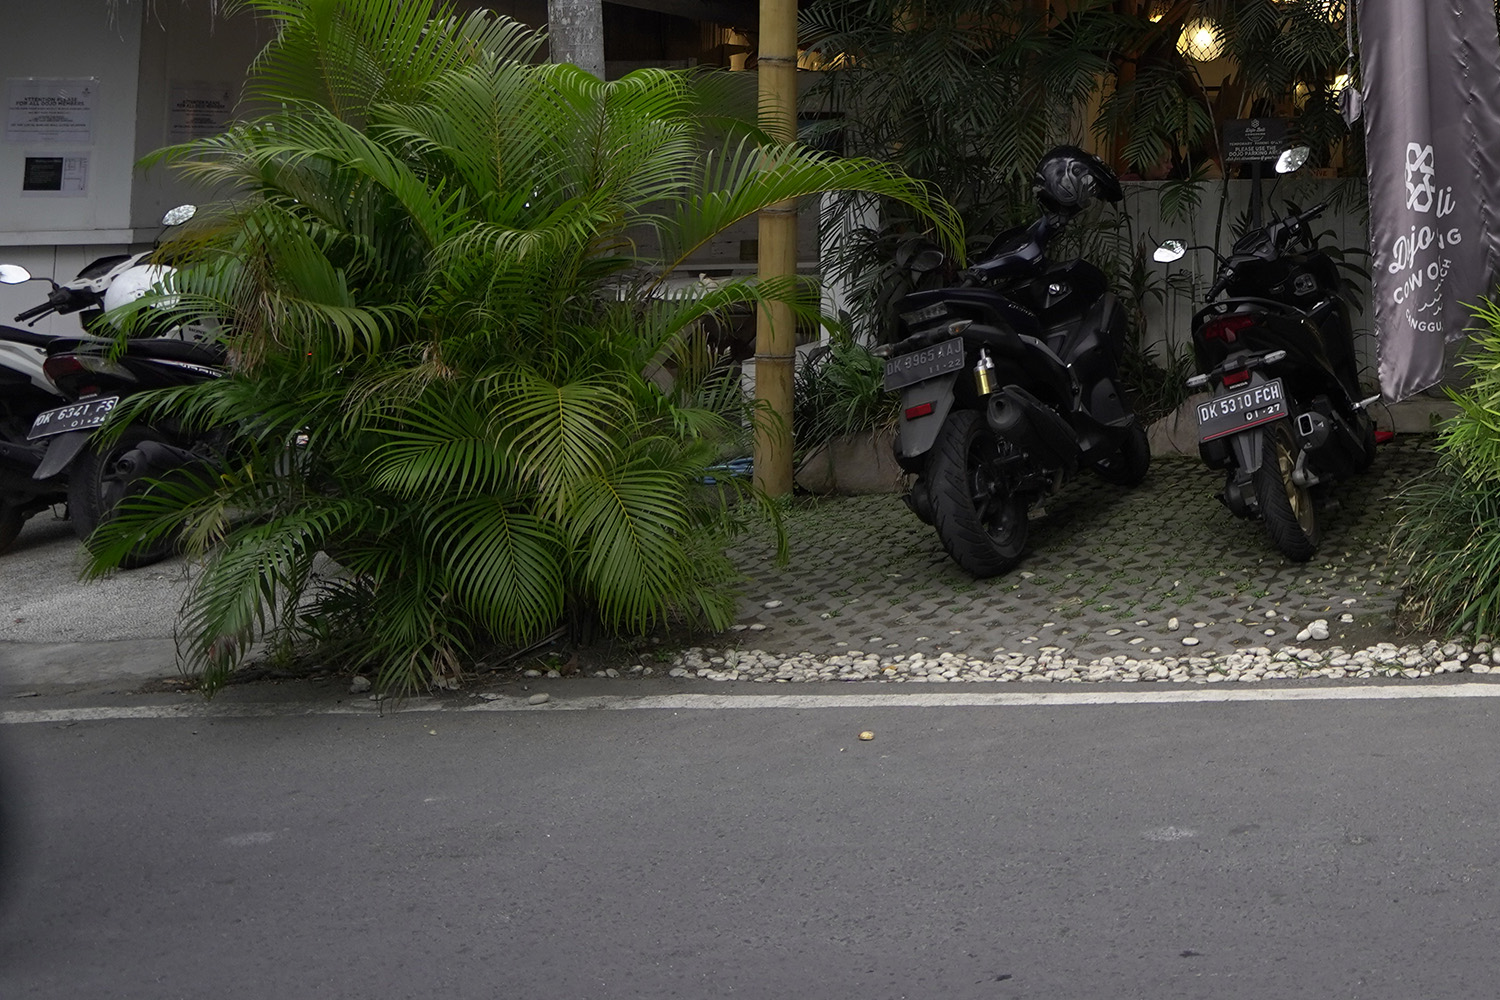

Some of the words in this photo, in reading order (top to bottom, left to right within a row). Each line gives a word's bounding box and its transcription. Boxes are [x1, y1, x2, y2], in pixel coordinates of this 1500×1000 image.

[886, 360, 901, 376] DK
[1200, 404, 1218, 422] DK
[1220, 394, 1252, 414] 5310
[1254, 385, 1279, 404] FCH
[58, 404, 91, 420] 6341
